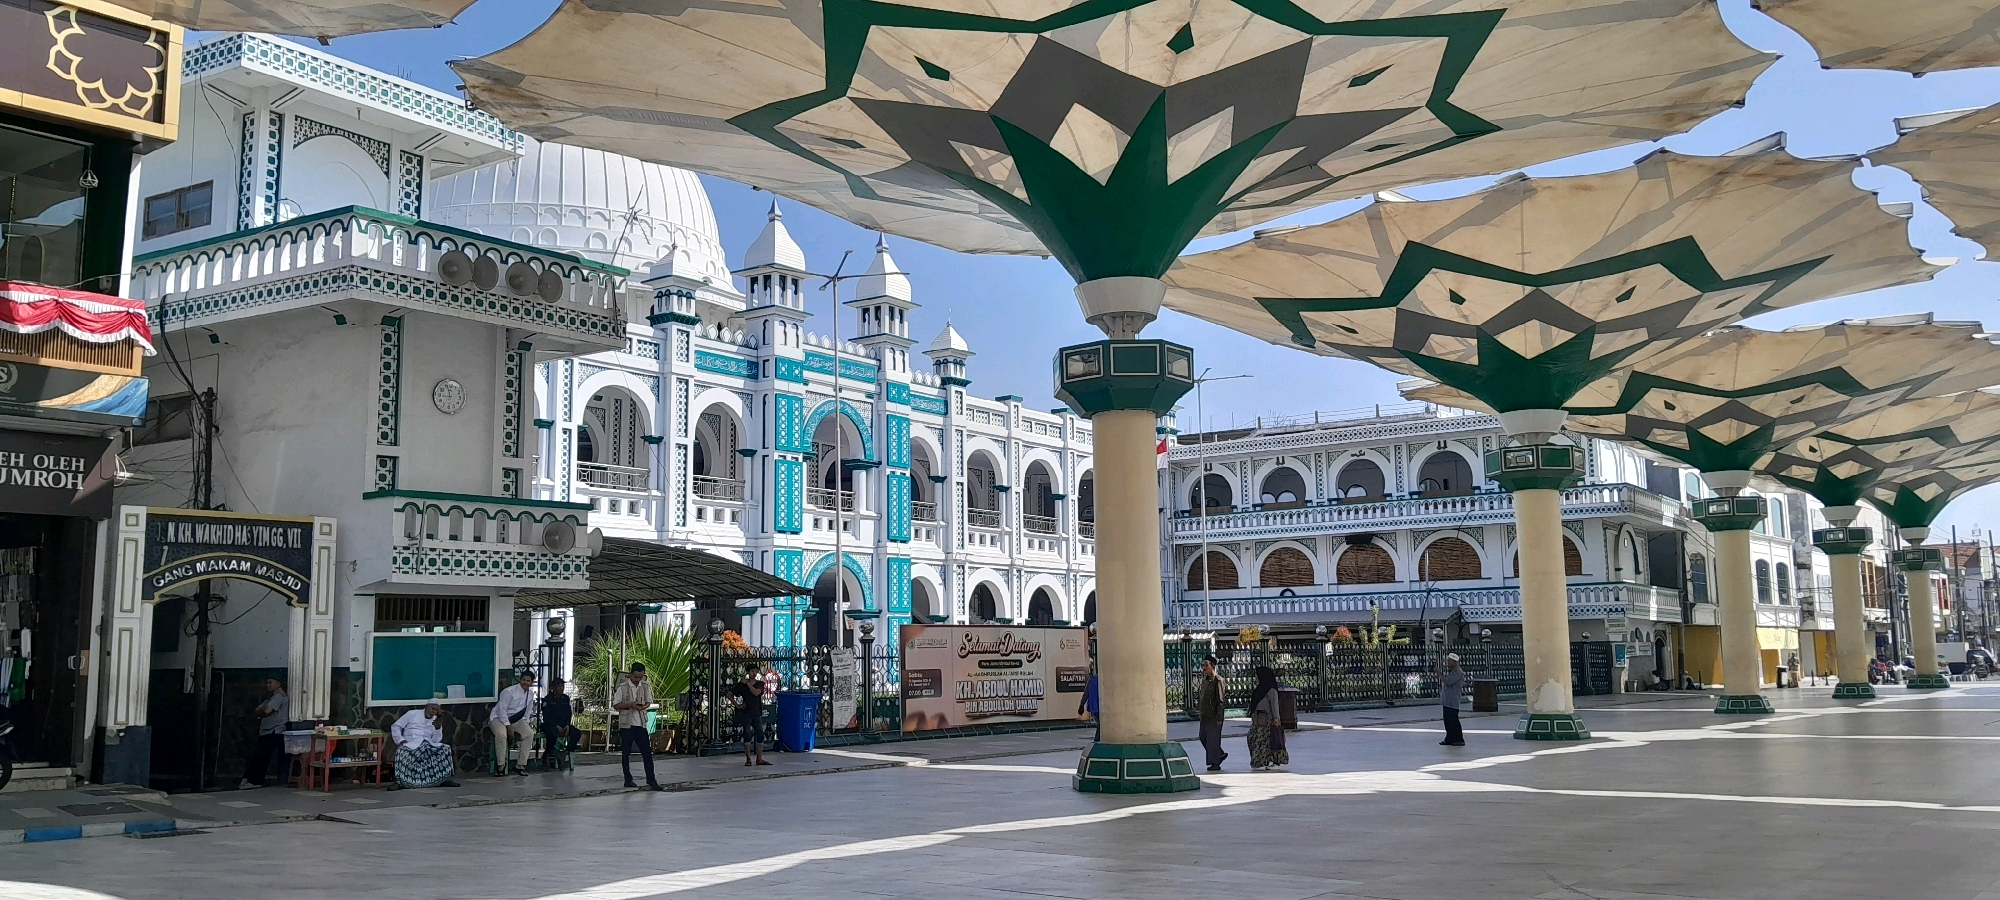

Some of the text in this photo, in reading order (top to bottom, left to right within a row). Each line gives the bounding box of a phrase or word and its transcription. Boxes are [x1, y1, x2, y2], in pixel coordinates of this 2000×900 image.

[0, 451, 86, 472] EH OLEH
[178, 522, 194, 544] KH.
[195, 522, 234, 545] WAKHID
[287, 527, 302, 549] VII
[152, 558, 302, 591] GANG MAKAM MASJID
[957, 630, 1042, 664] Selamat Datang
[955, 679, 1045, 700] KH. ABDUL HAMID
[978, 699, 1015, 712] ABDULLOH
[1016, 699, 1038, 711] UMAR
